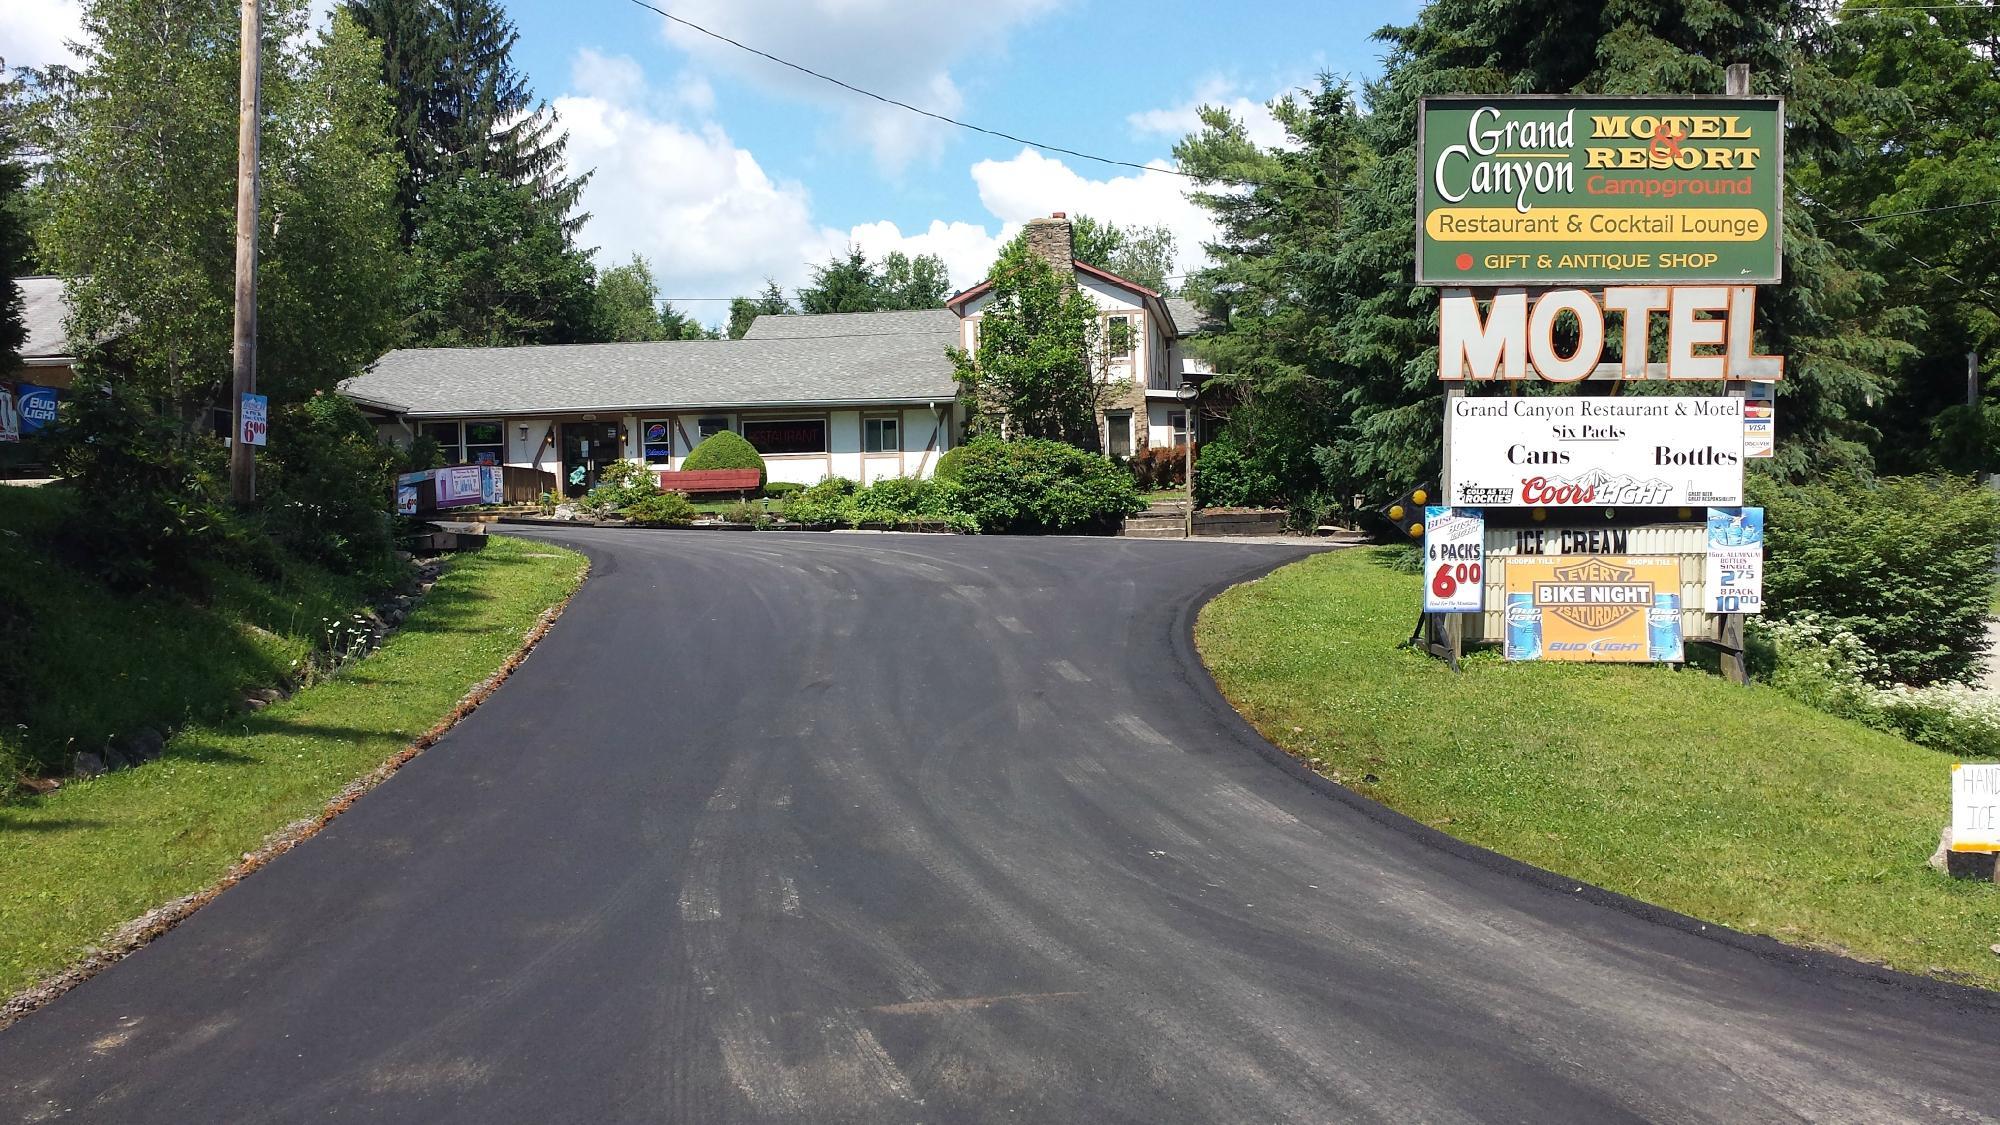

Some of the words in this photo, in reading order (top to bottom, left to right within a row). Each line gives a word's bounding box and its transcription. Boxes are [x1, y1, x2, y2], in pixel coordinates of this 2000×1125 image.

[1467, 106, 1576, 156] Grand
[1590, 115, 1752, 140] MOTEL
[1649, 123, 1687, 159] &
[1583, 147, 1760, 170] RESORT
[1434, 145, 1575, 213] Canyon
[1587, 175, 1752, 198] Campground
[1439, 214, 1559, 234] Restaurant
[1566, 214, 1583, 234] &
[1589, 213, 1674, 234] Cocktail
[1681, 214, 1760, 237] Lounge
[1484, 254, 1532, 269] GIFT
[1536, 254, 1553, 269] &
[1557, 254, 1651, 270] ANTIQUE
[1659, 253, 1718, 268] SHOP
[1439, 285, 1784, 382] MOTEL
[30, 397, 56, 411] BUD
[1456, 400, 1508, 418] Grand
[1514, 400, 1576, 421] Canyon
[1581, 401, 1669, 417] Restaurant
[1674, 401, 1688, 416] &
[1694, 400, 1740, 417] Motel
[1552, 424, 1577, 439] Six
[1582, 424, 1626, 439] Packs
[1507, 444, 1571, 466] Cans
[1655, 445, 1738, 466] Bottles
[1464, 494, 1512, 503] ROCKIES
[1521, 476, 1596, 505] Coors
[1595, 484, 1674, 505] LIGHT
[1429, 543, 1437, 561] 6
[1441, 543, 1481, 561] PACKS
[1516, 529, 1544, 555] ICE
[1560, 529, 1628, 554] CREAM
[1568, 565, 1621, 582] EVERY
[1539, 586, 1586, 603] BIKE
[1590, 586, 1650, 603] NIGHT
[1563, 606, 1627, 627] SATURDAY
[1548, 642, 1588, 651] BUD
[1592, 642, 1643, 651] LIGHT
[1966, 805, 1996, 830] ICE
